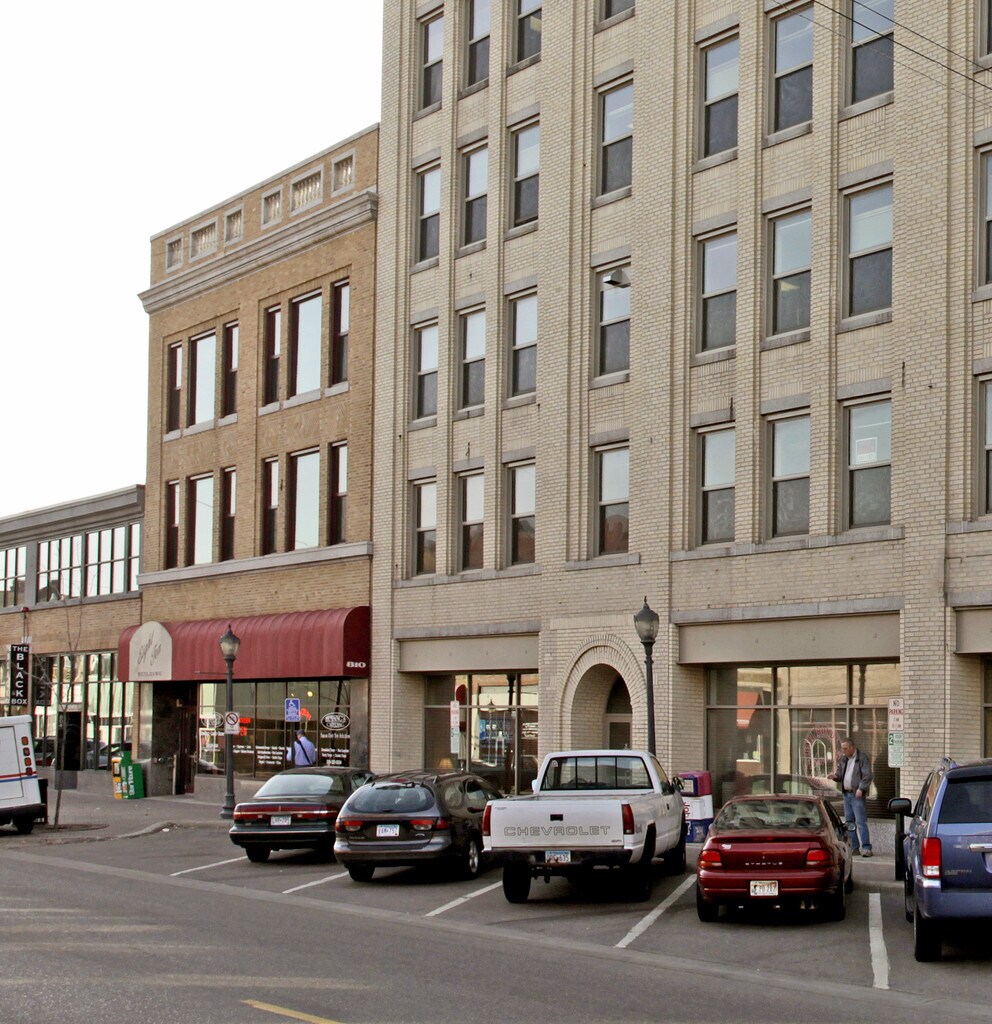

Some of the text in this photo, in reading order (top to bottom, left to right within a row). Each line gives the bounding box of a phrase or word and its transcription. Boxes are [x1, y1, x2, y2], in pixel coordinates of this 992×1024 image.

[15, 653, 25, 698] BLACK
[888, 708, 903, 716] PARKING
[503, 825, 611, 837] CHEVROLET
